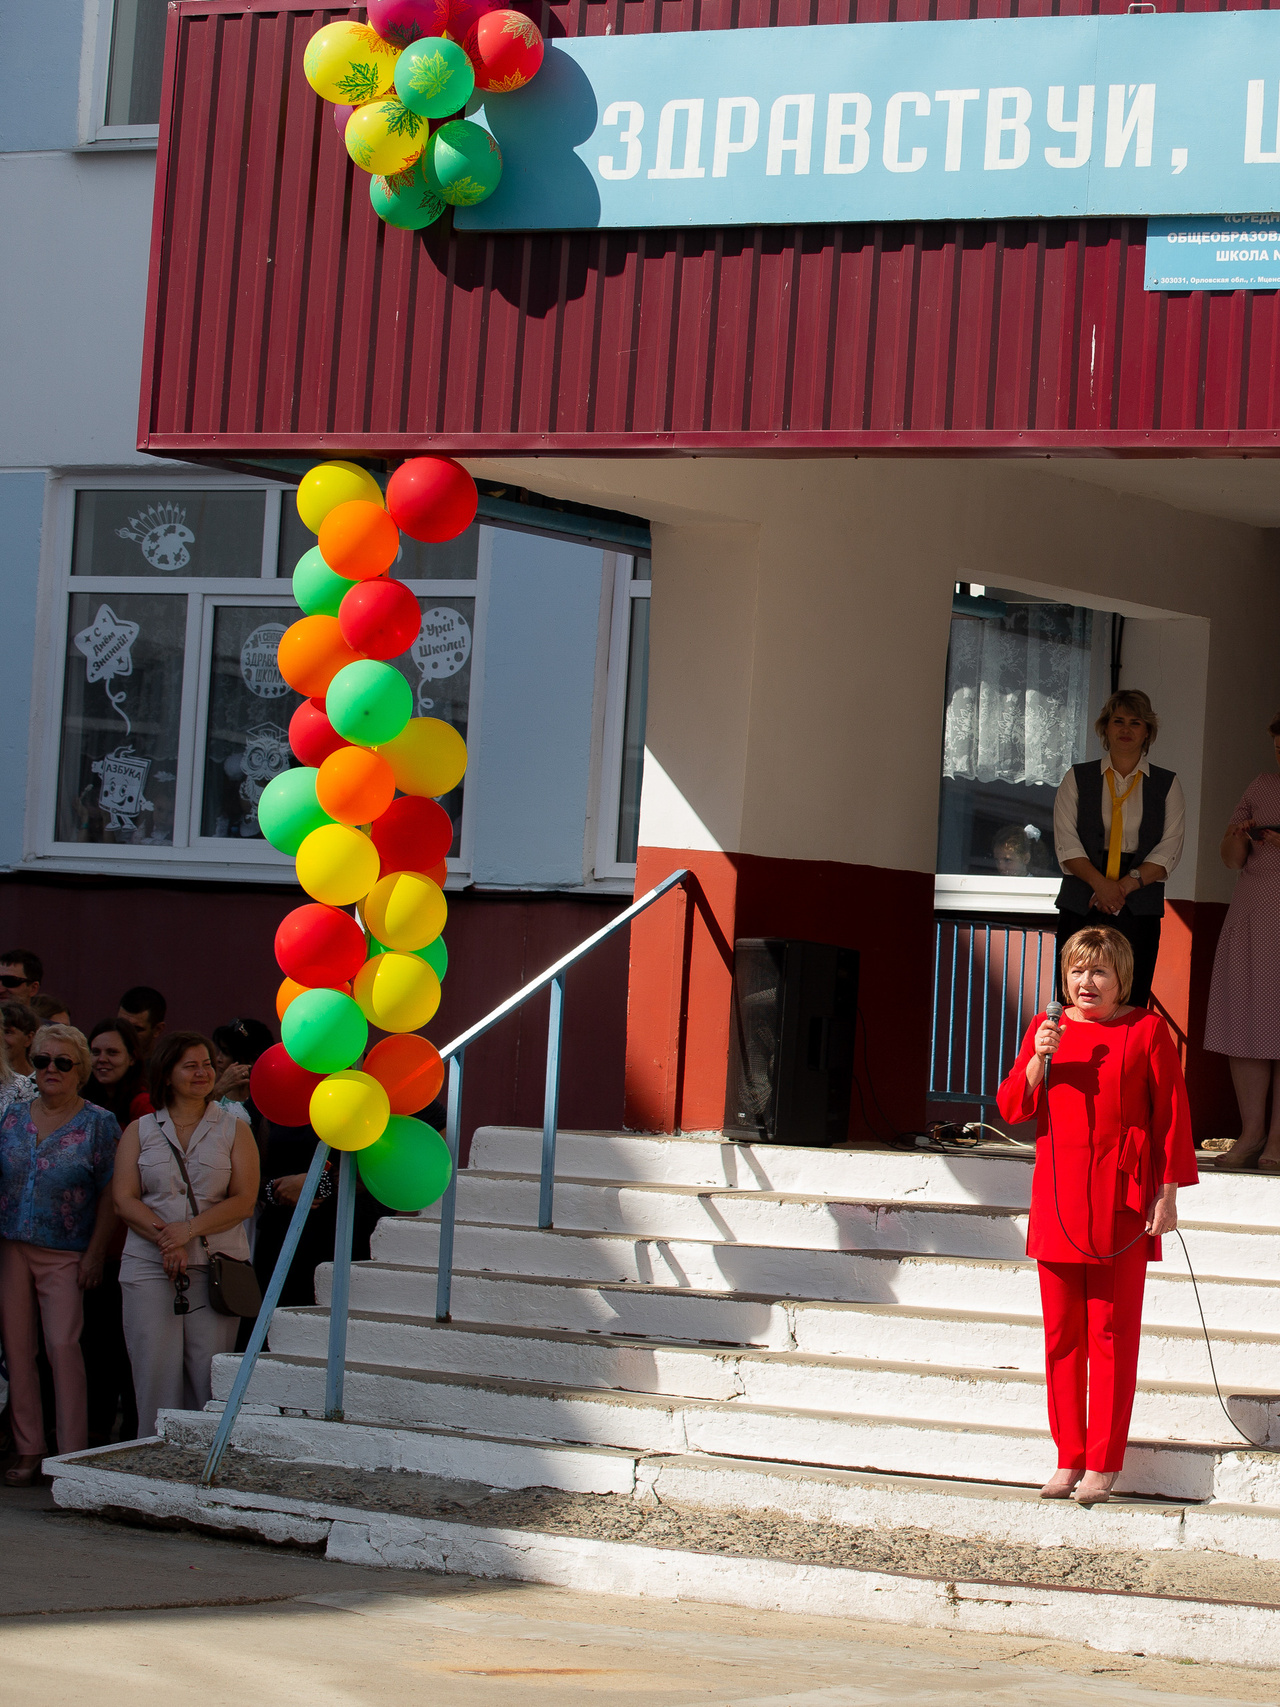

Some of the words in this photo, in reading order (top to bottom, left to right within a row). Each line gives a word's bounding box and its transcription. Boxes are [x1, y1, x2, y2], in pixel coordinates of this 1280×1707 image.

[597, 83, 1189, 180] ЗДРАВСТВУЙ,
[1216, 249, 1270, 262] ШКОЛА
[1160, 277, 1189, 285] 303031,
[93, 627, 101, 637] С
[426, 619, 455, 637] Ура!
[92, 634, 129, 671] Знаний!
[93, 632, 116, 657] Днём
[419, 636, 466, 657] Школа!
[245, 652, 278, 668] ЗДРАВС
[255, 668, 286, 684] ШКОЛА
[106, 763, 141, 781] АЗБУКА
